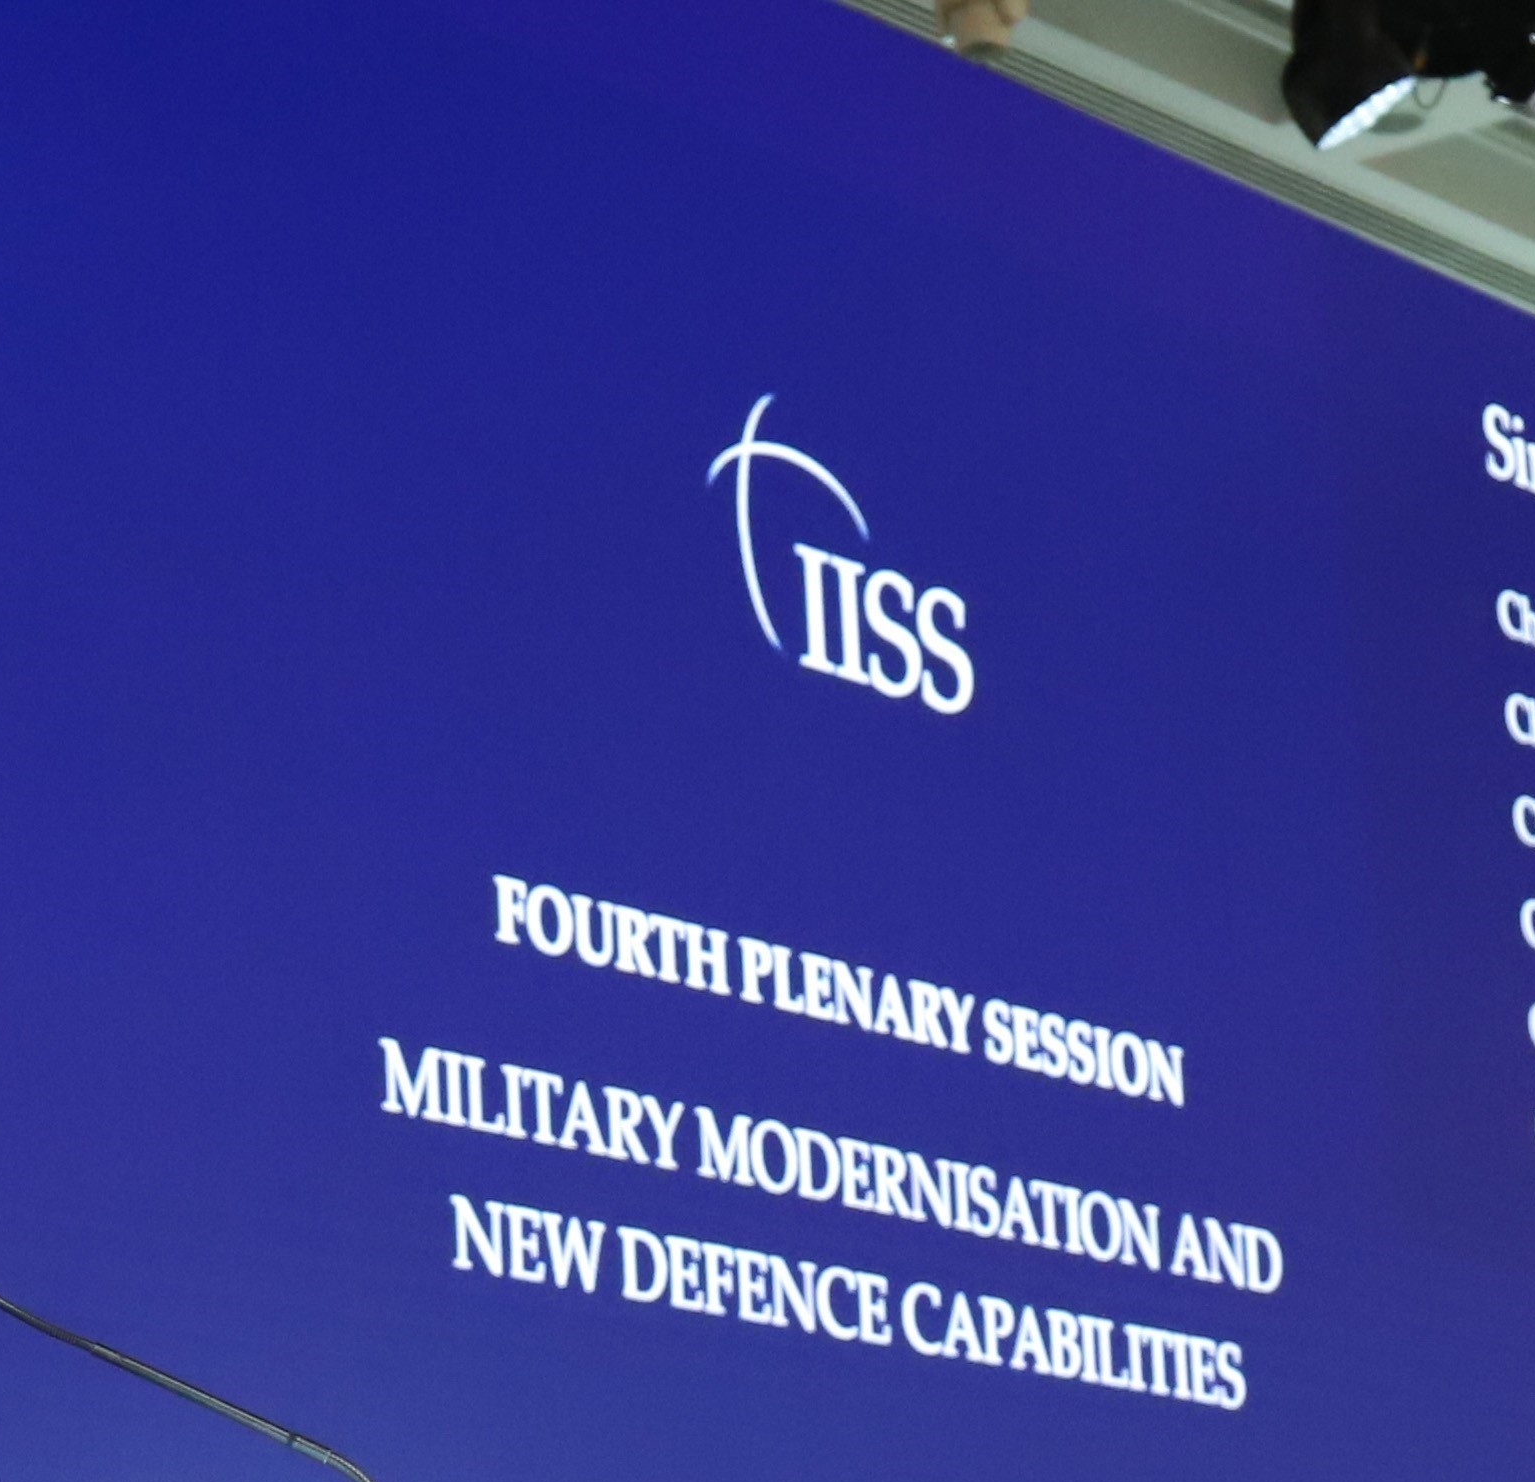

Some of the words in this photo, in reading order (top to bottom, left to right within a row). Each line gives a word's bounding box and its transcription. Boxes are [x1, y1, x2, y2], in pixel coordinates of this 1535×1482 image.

[793, 542, 975, 715] IISS
[492, 874, 731, 996] FOURTH
[738, 936, 975, 1055] PLENARY
[983, 999, 1185, 1107] SESSION
[378, 1037, 685, 1171] MILITARY
[694, 1105, 1161, 1271] MODERNISATION
[1170, 1214, 1283, 1294] AND
[450, 1194, 607, 1294] NEW
[616, 1226, 893, 1346] DEFENCE
[902, 1282, 1247, 1412] CAPABILITIES
